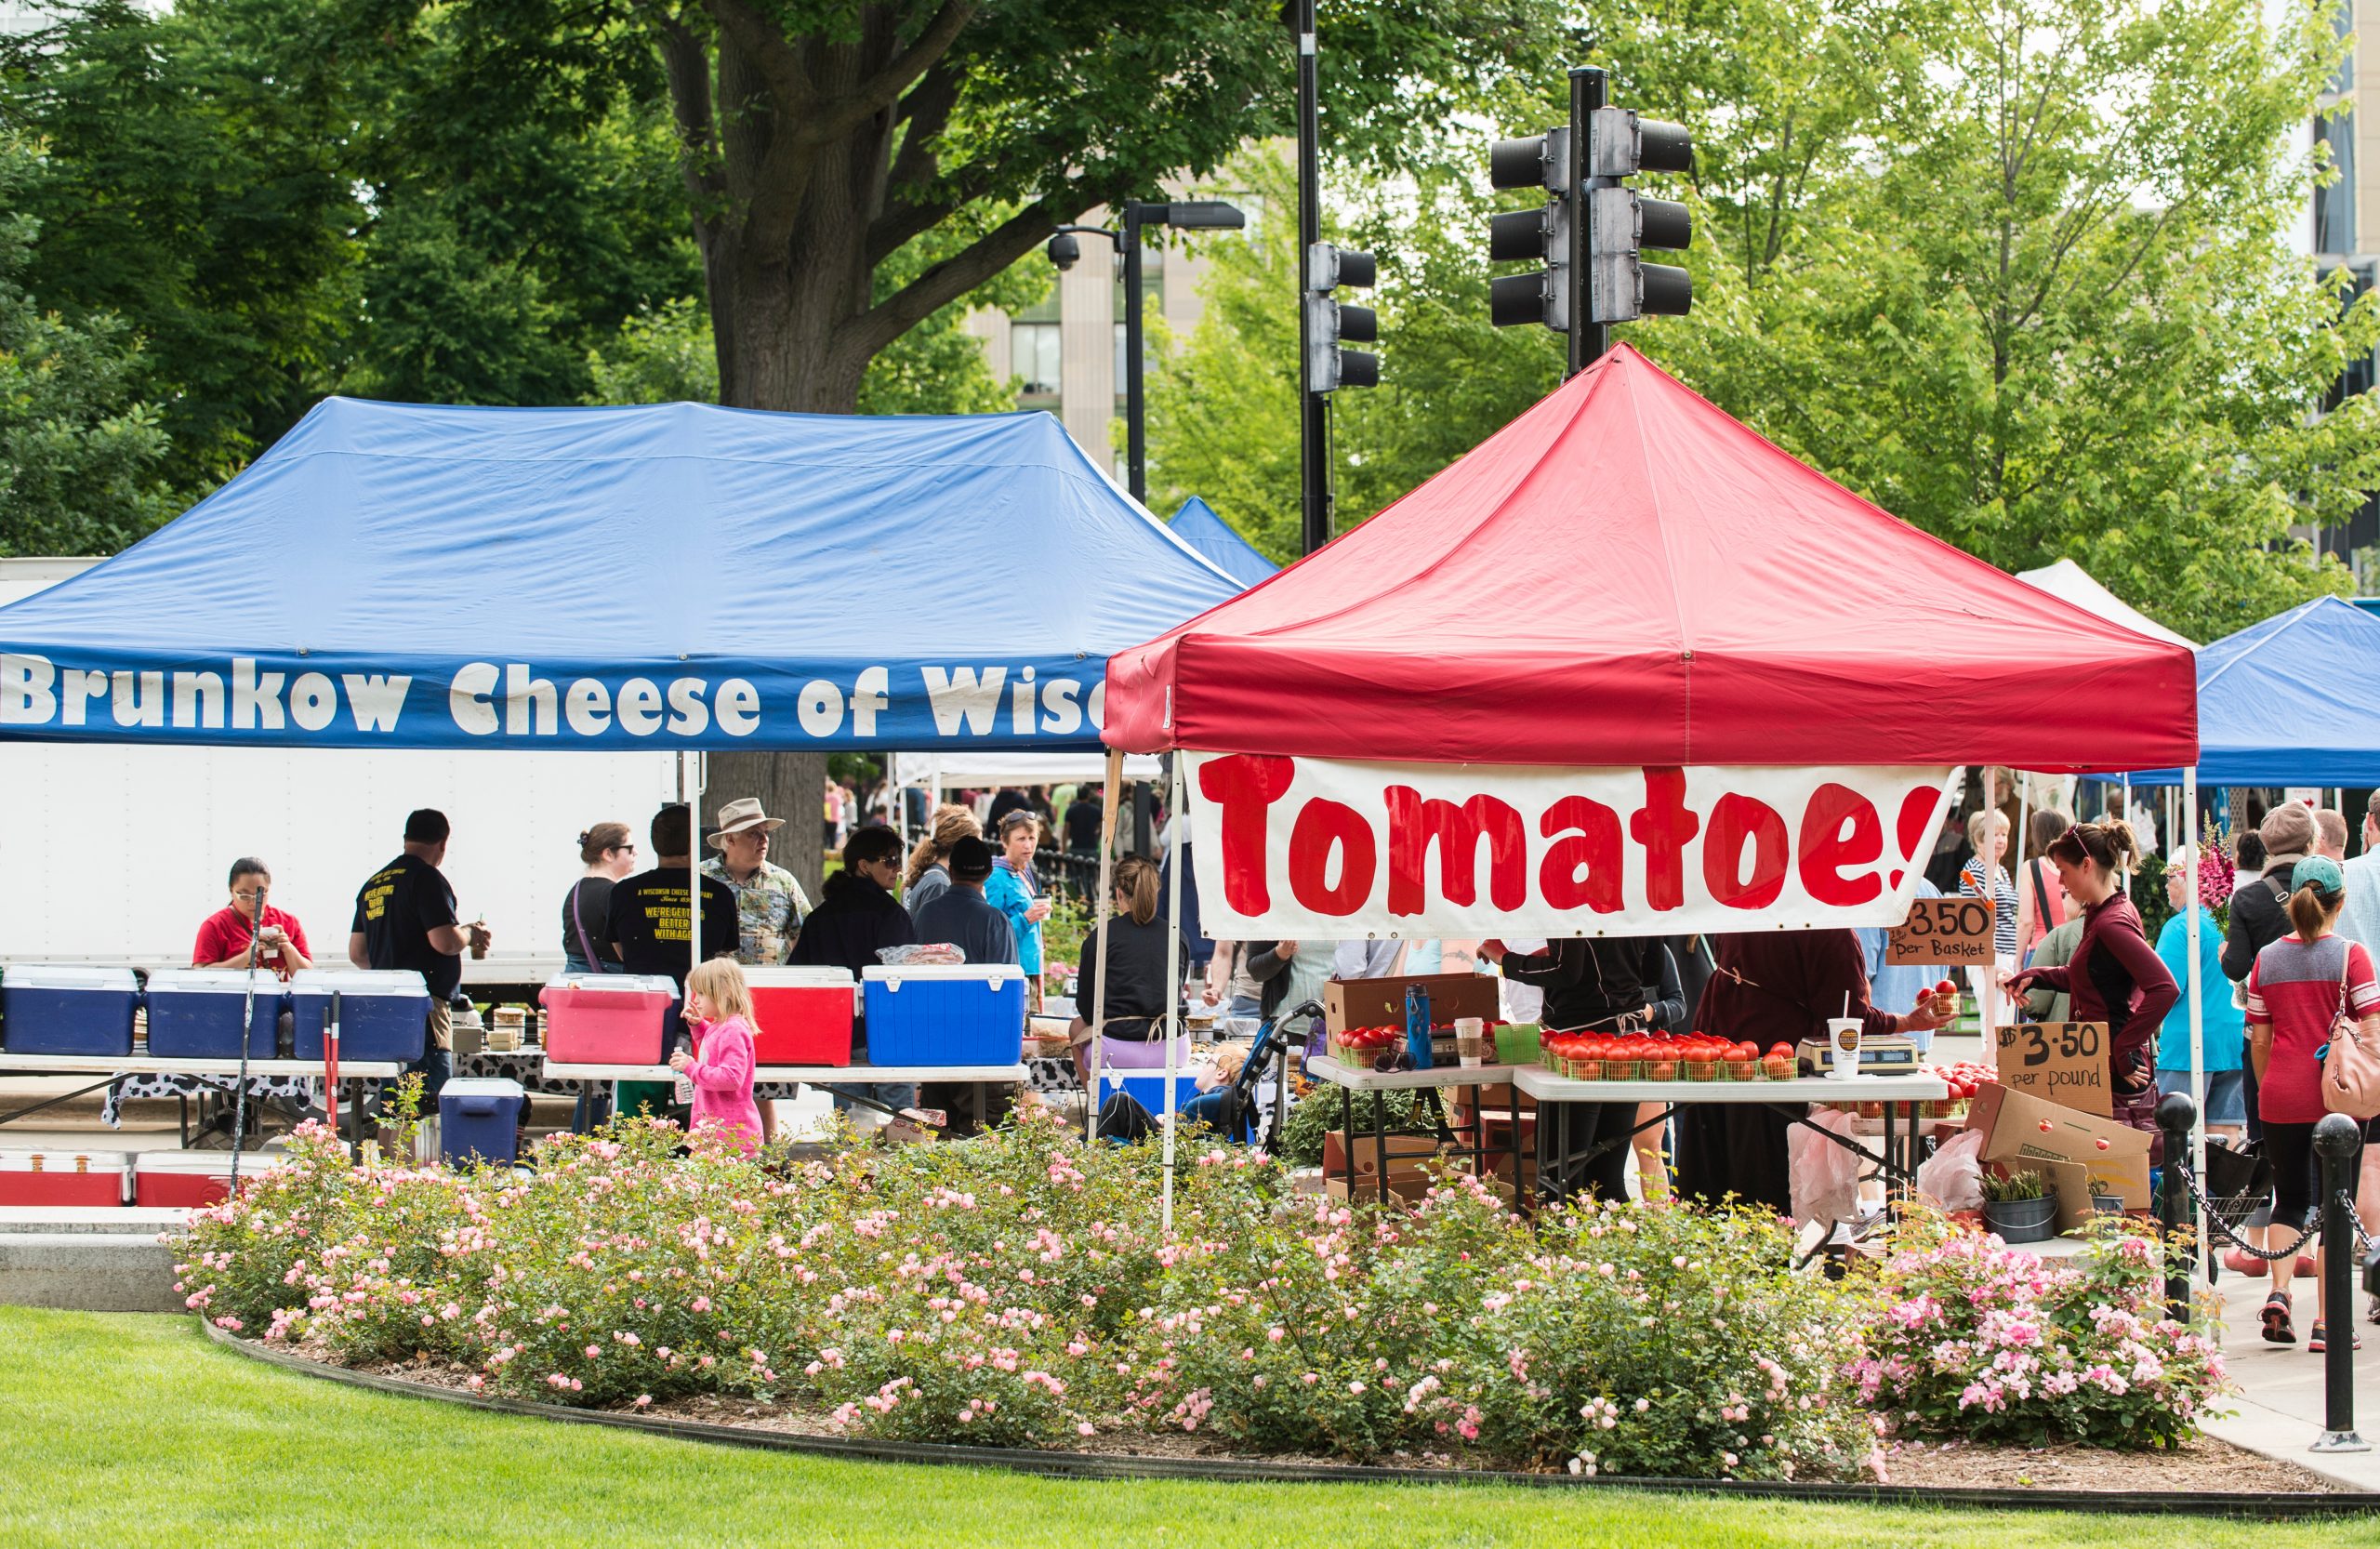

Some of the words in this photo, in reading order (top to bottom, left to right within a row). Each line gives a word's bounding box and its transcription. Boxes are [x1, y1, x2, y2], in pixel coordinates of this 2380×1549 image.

[0, 654, 413, 733] Brunkow
[449, 662, 760, 737] Cheese
[798, 666, 889, 737] of
[645, 907, 670, 918] WE'RE
[659, 918, 690, 929] BETTER
[654, 928, 676, 940] WITH
[676, 930, 693, 940] AGE
[1896, 943, 1924, 960] per
[1931, 939, 1985, 957] Basket
[2011, 1071, 2040, 1088] per
[2048, 1063, 2101, 1095] pound
